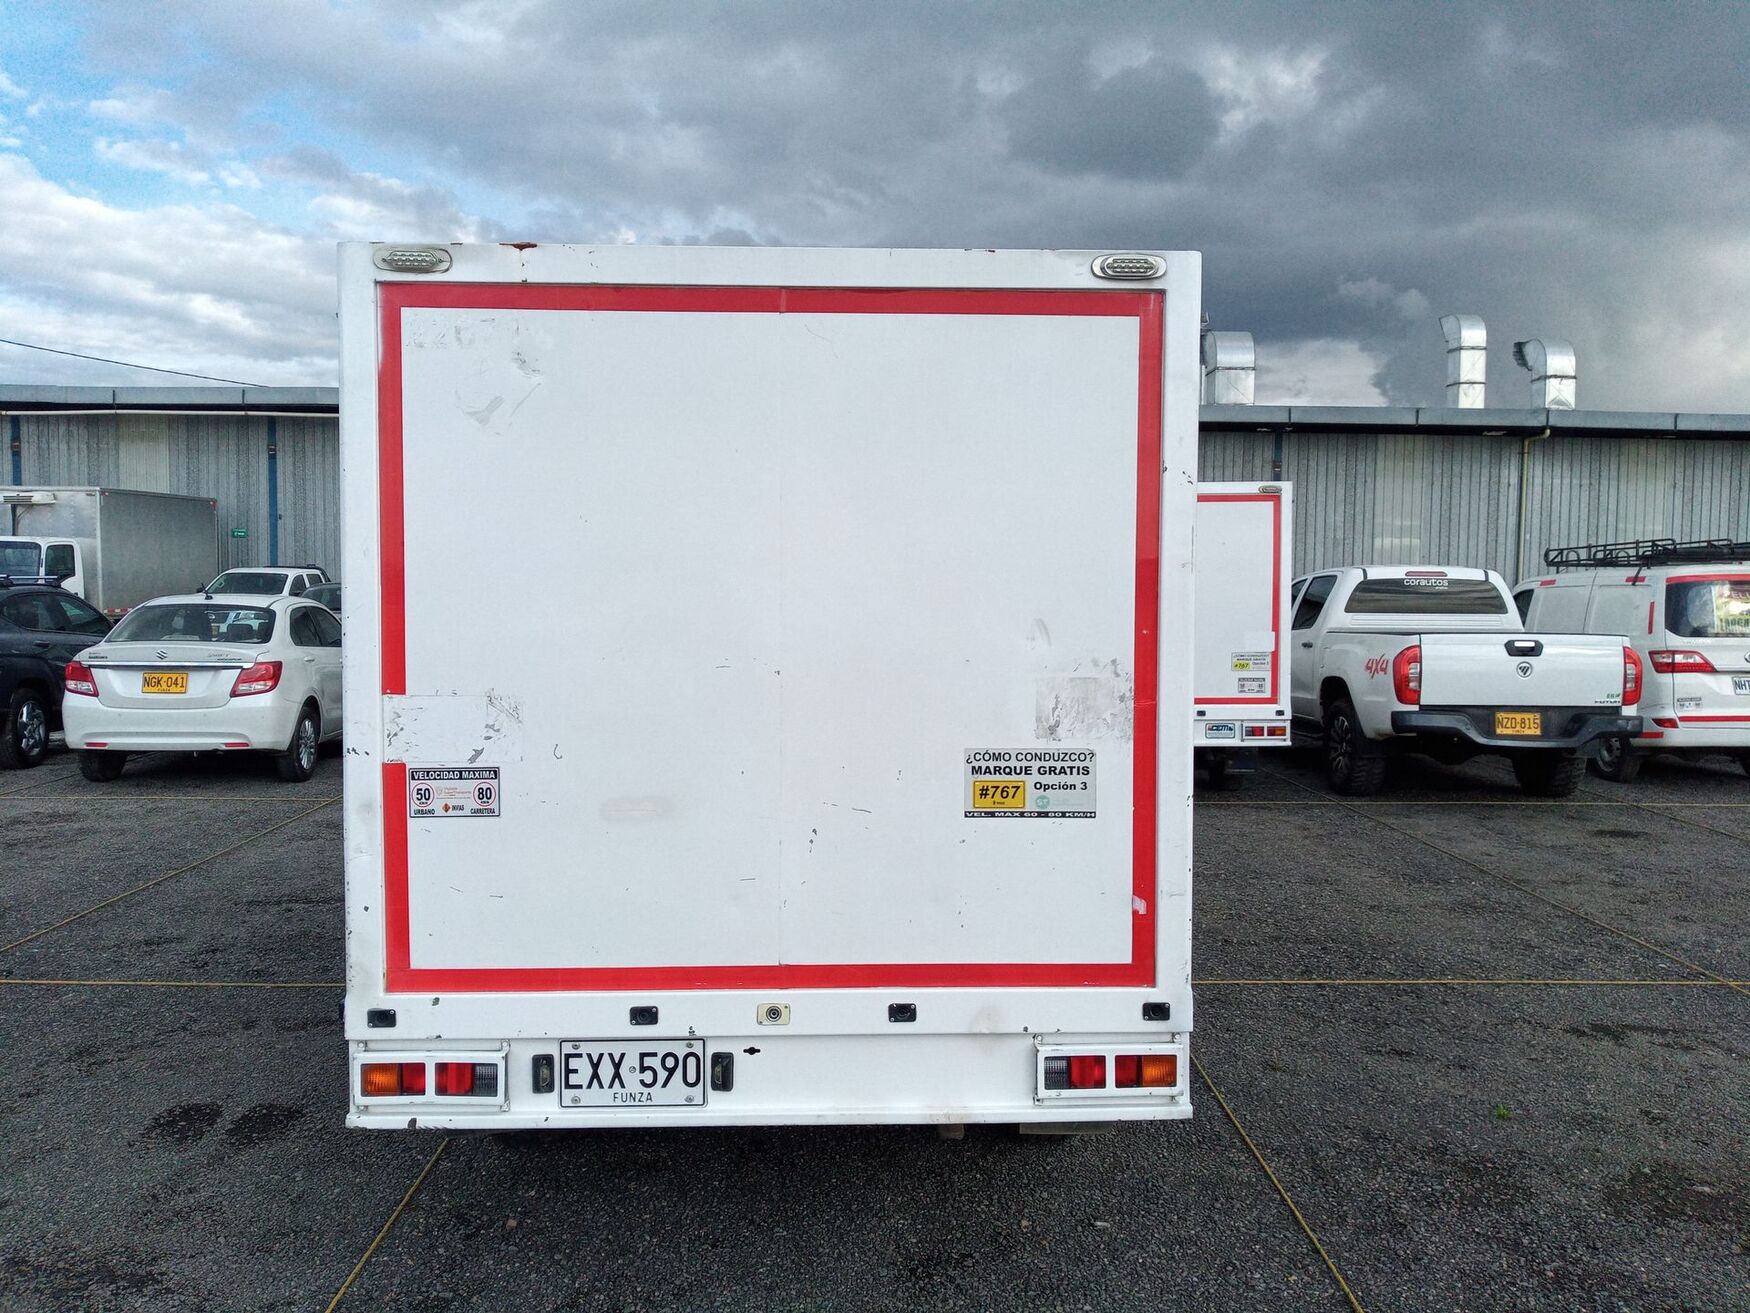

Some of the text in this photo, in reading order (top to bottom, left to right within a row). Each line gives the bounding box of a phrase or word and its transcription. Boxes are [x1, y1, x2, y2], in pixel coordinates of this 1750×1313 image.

[966, 750, 1095, 764] ¿CÓMO CONDUZCO?
[413, 770, 496, 780] VELOCIDAD MAXIMA
[971, 765, 1090, 776] MARQUE GRATIS
[979, 785, 1021, 800] #767
[1033, 781, 1088, 792] Opción 3
[415, 787, 431, 801] 50
[477, 786, 493, 801] 80
[413, 808, 436, 816] URBANO
[470, 807, 496, 815] CARRETERA
[563, 1051, 701, 1090] EXX 590
[613, 1091, 653, 1103] FUNZA
